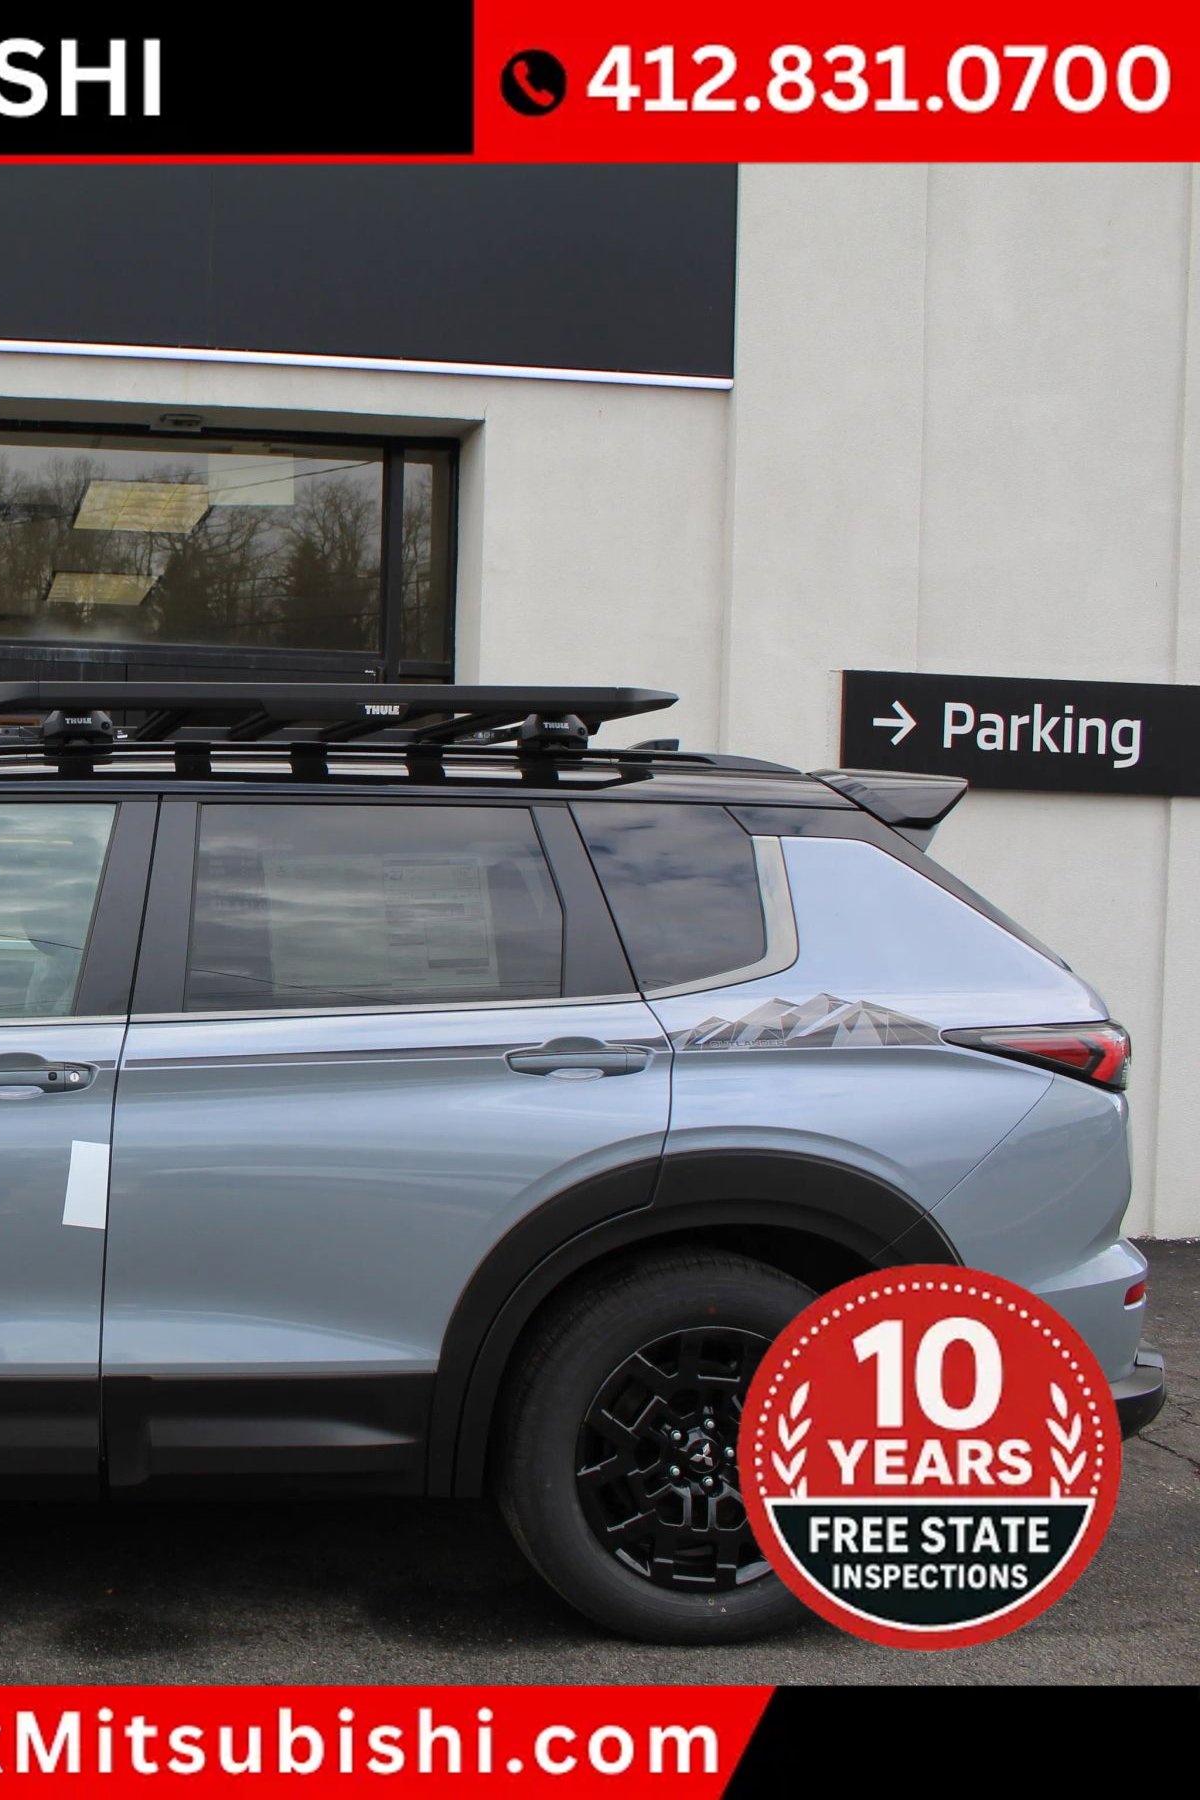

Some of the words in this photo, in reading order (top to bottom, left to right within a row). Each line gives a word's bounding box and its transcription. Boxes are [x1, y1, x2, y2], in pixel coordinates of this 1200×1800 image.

[364, 704, 400, 716] THULE
[64, 717, 93, 725] THULE
[543, 721, 569, 730] THULE
[943, 701, 1142, 769] Parking
[710, 1040, 787, 1048] OUTLANDER
